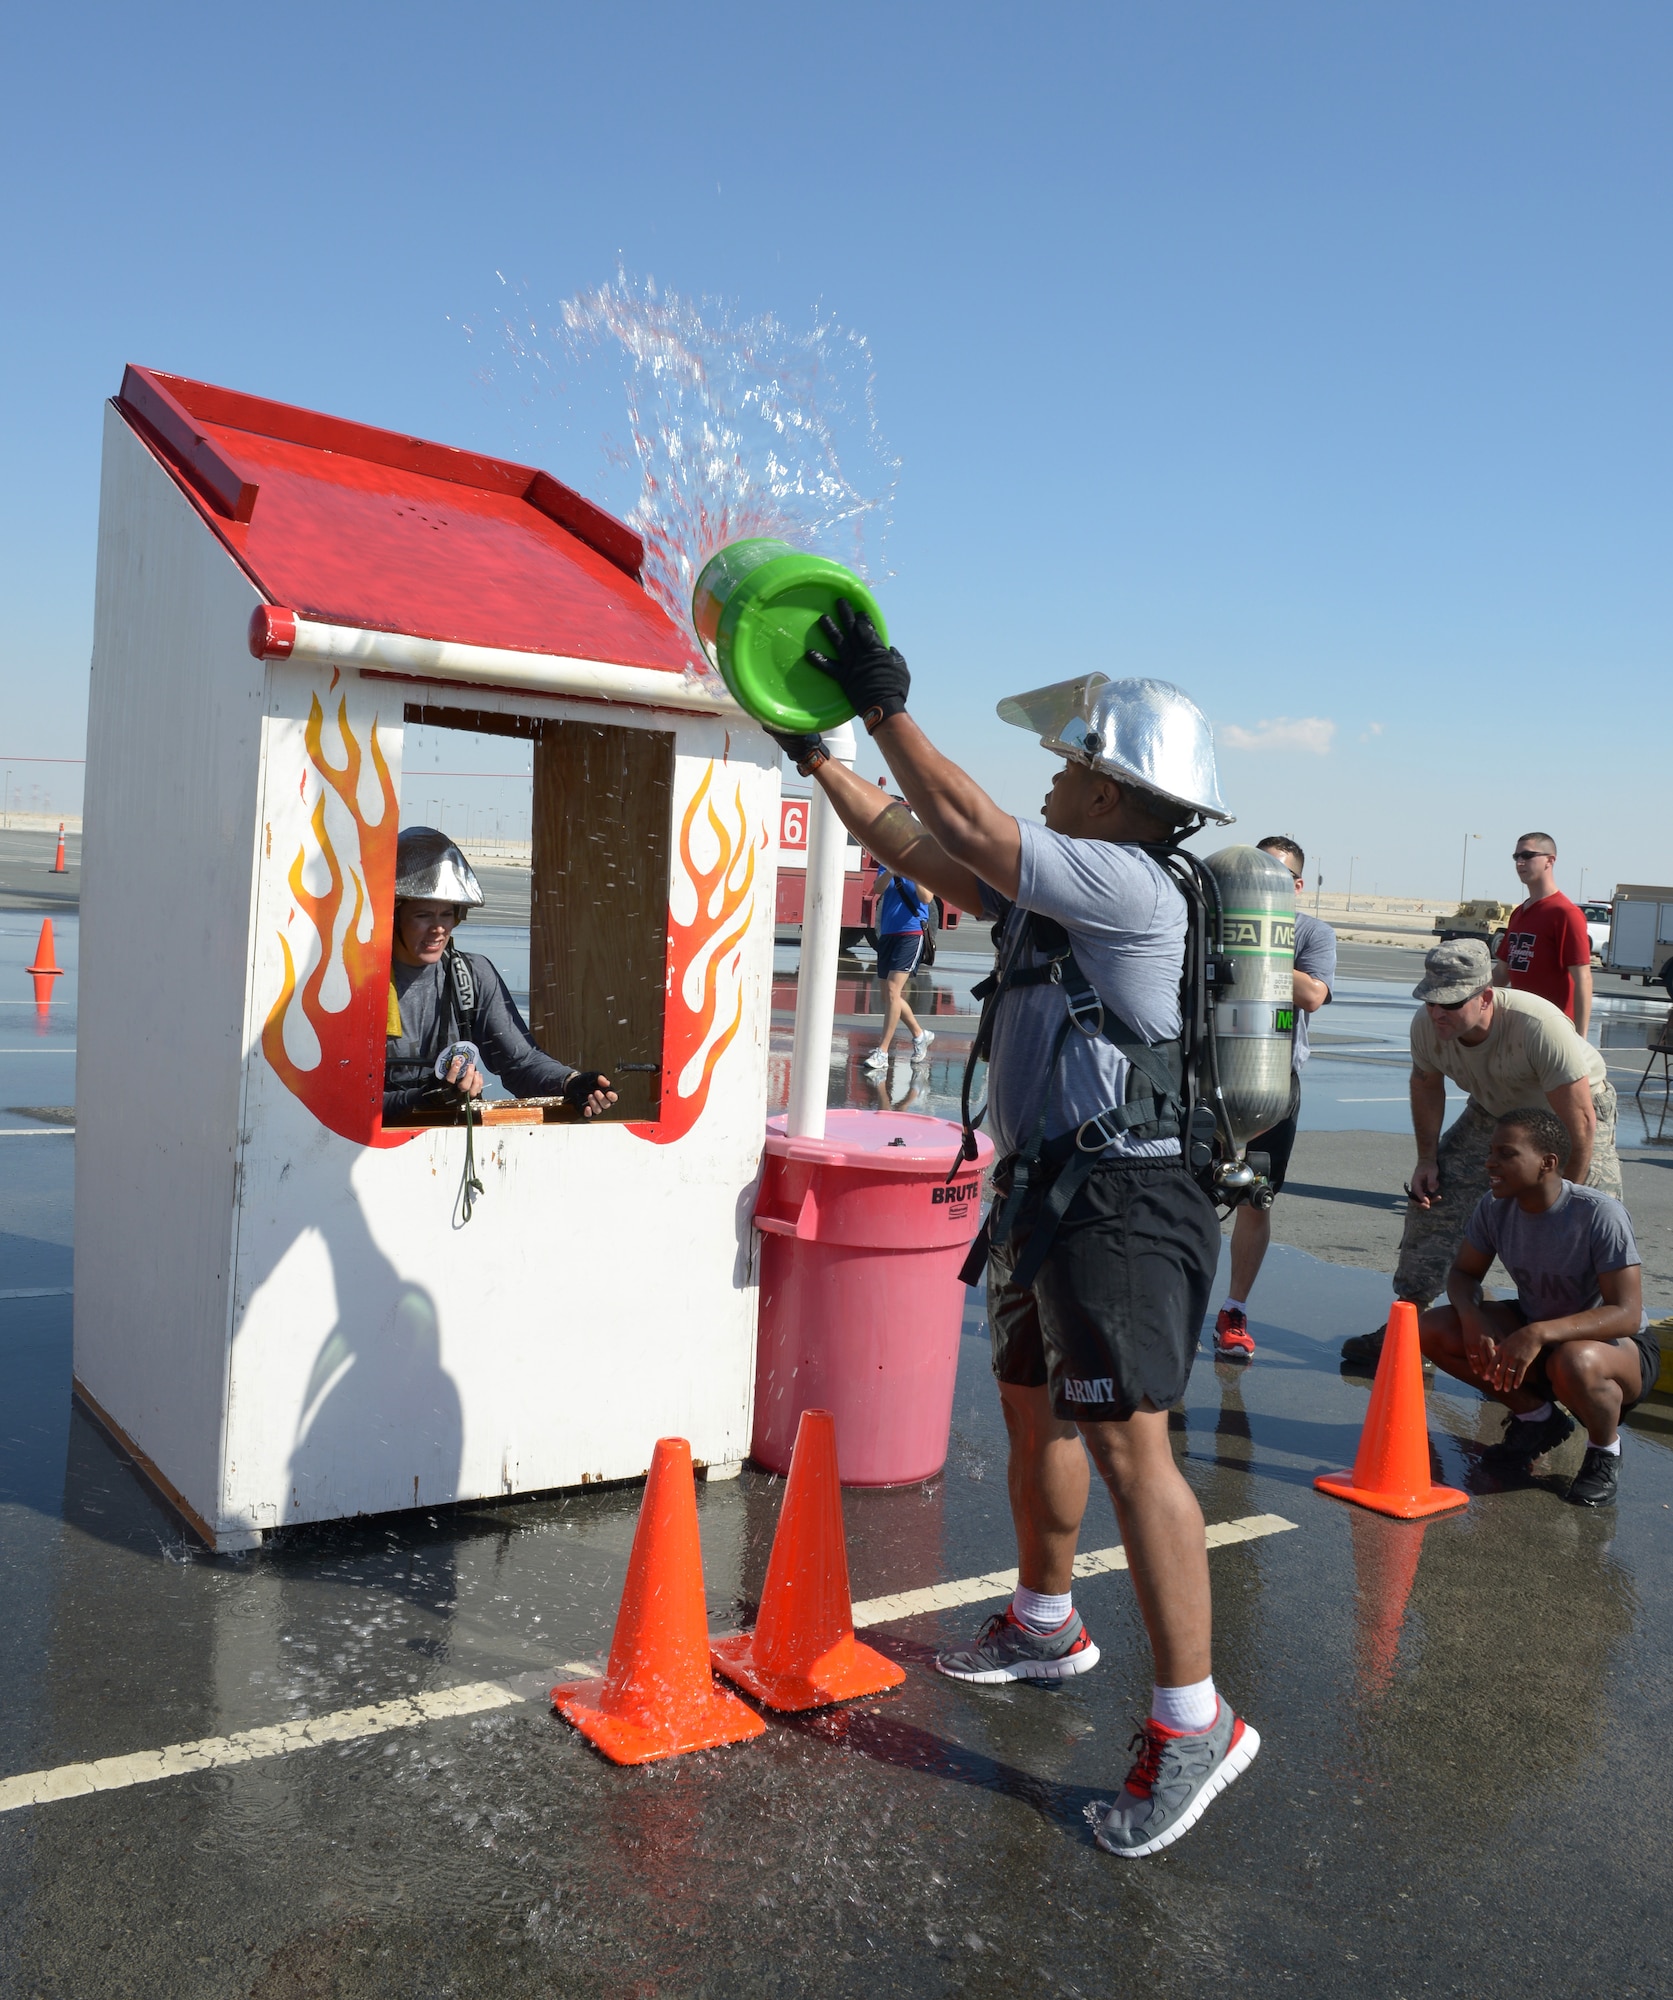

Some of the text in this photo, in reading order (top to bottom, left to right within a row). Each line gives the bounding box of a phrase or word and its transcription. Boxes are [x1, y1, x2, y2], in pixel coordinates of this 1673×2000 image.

[784, 807, 803, 844] 6
[1223, 922, 1258, 943] SA
[453, 960, 472, 1006] MSA
[931, 1181, 978, 1204] BRUTE
[1064, 1377, 1115, 1403] ARMY
